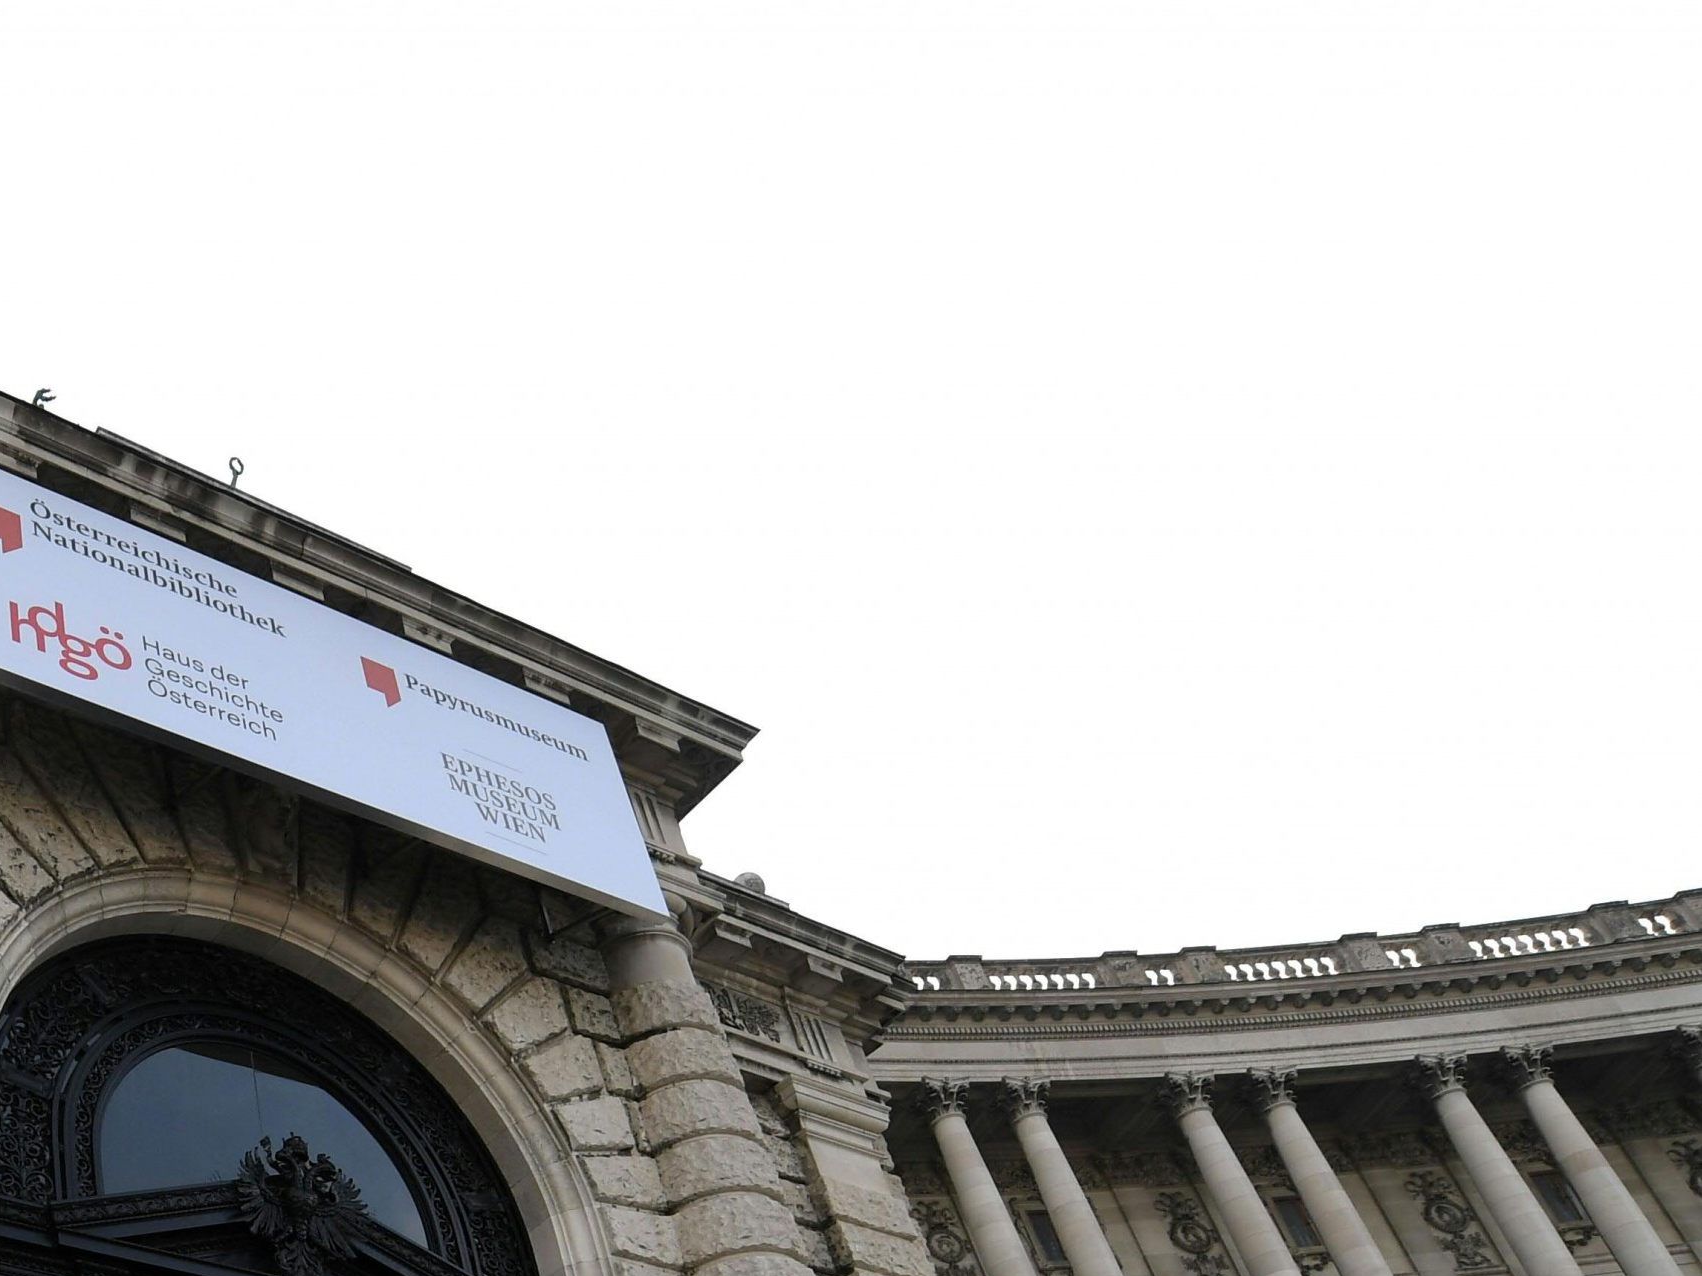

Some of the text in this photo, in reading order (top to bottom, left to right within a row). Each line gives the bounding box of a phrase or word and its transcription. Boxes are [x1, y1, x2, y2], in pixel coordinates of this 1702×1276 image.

[30, 498, 238, 599] Österreichische
[31, 520, 287, 638] Nationalbibliothek
[9, 600, 132, 681] hdgö
[142, 635, 249, 690] Haus der
[144, 658, 284, 724] Geschichte
[148, 675, 277, 741] Österreich
[403, 673, 590, 762] Papyrusmuseum
[441, 752, 558, 811] EPHESOS
[447, 773, 562, 831] MUSEUM
[474, 802, 547, 844] WIEN
